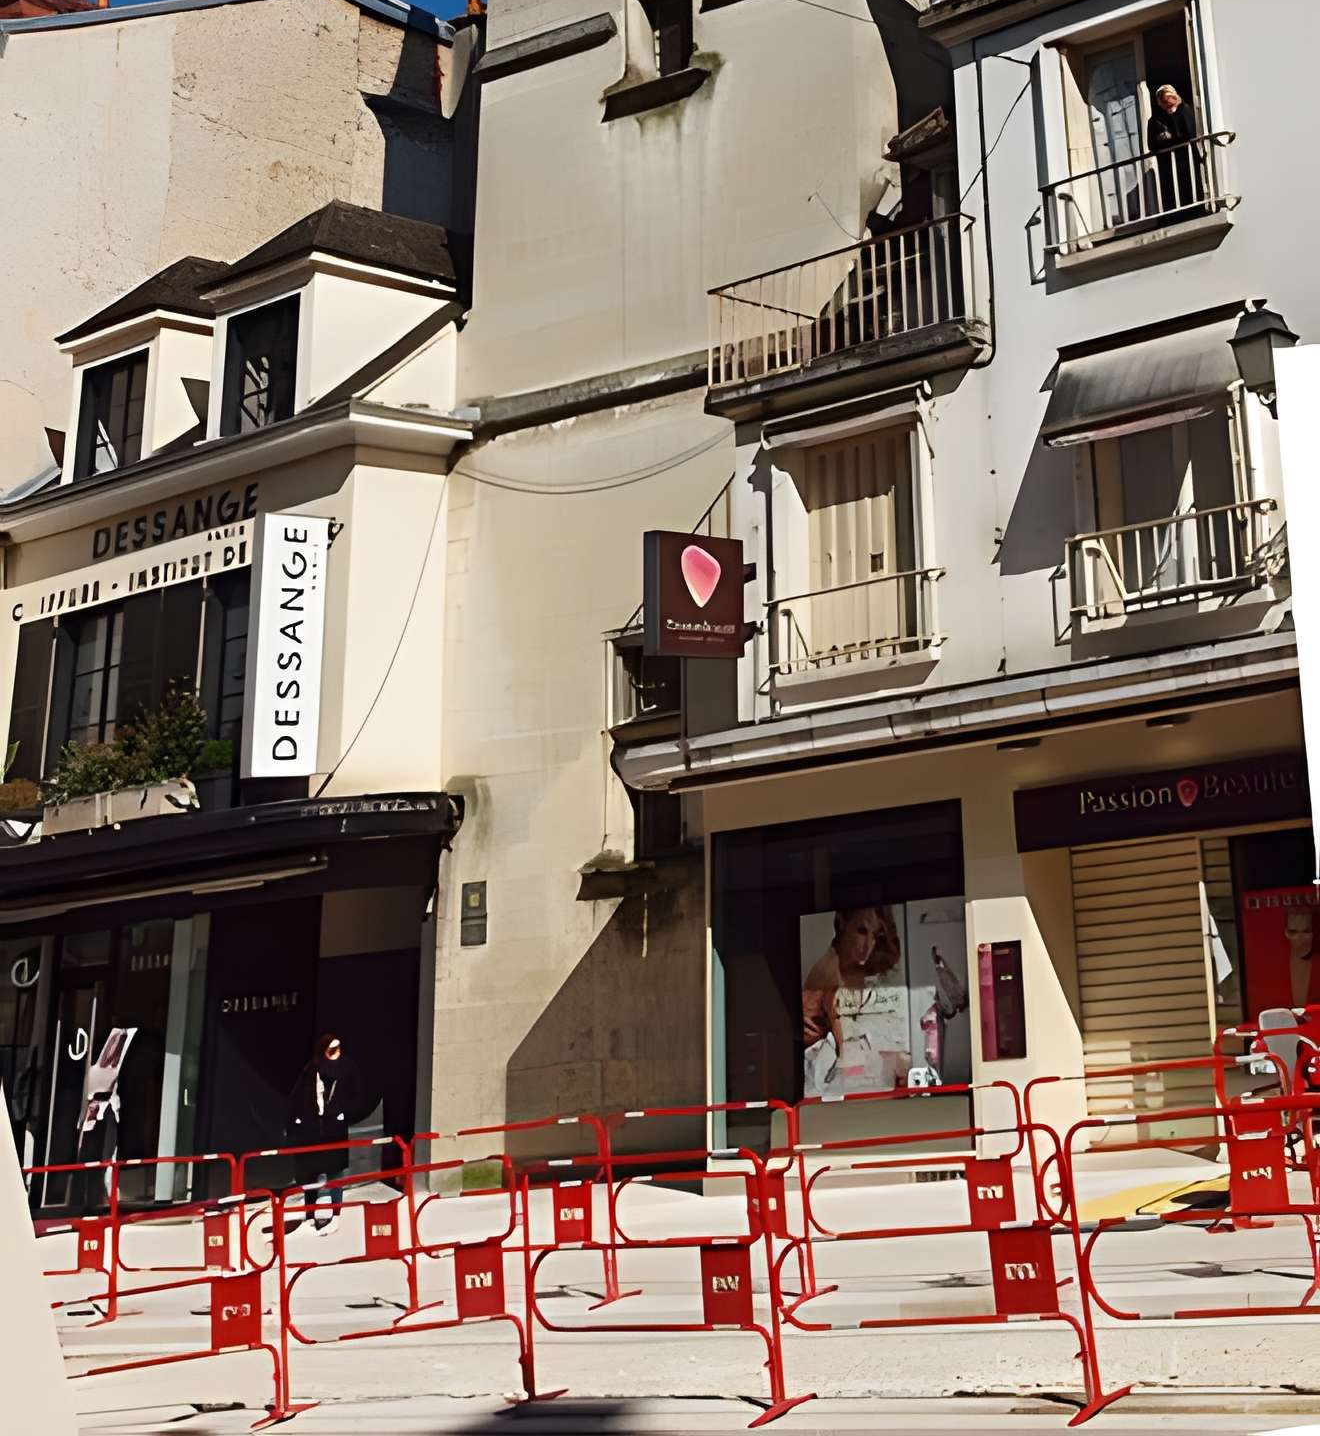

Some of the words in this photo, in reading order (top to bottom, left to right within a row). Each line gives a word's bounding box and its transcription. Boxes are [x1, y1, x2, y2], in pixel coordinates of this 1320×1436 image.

[93, 482, 258, 559] DESSANGE
[272, 527, 307, 761] DESSANGE
[1080, 785, 1172, 814] Passion
